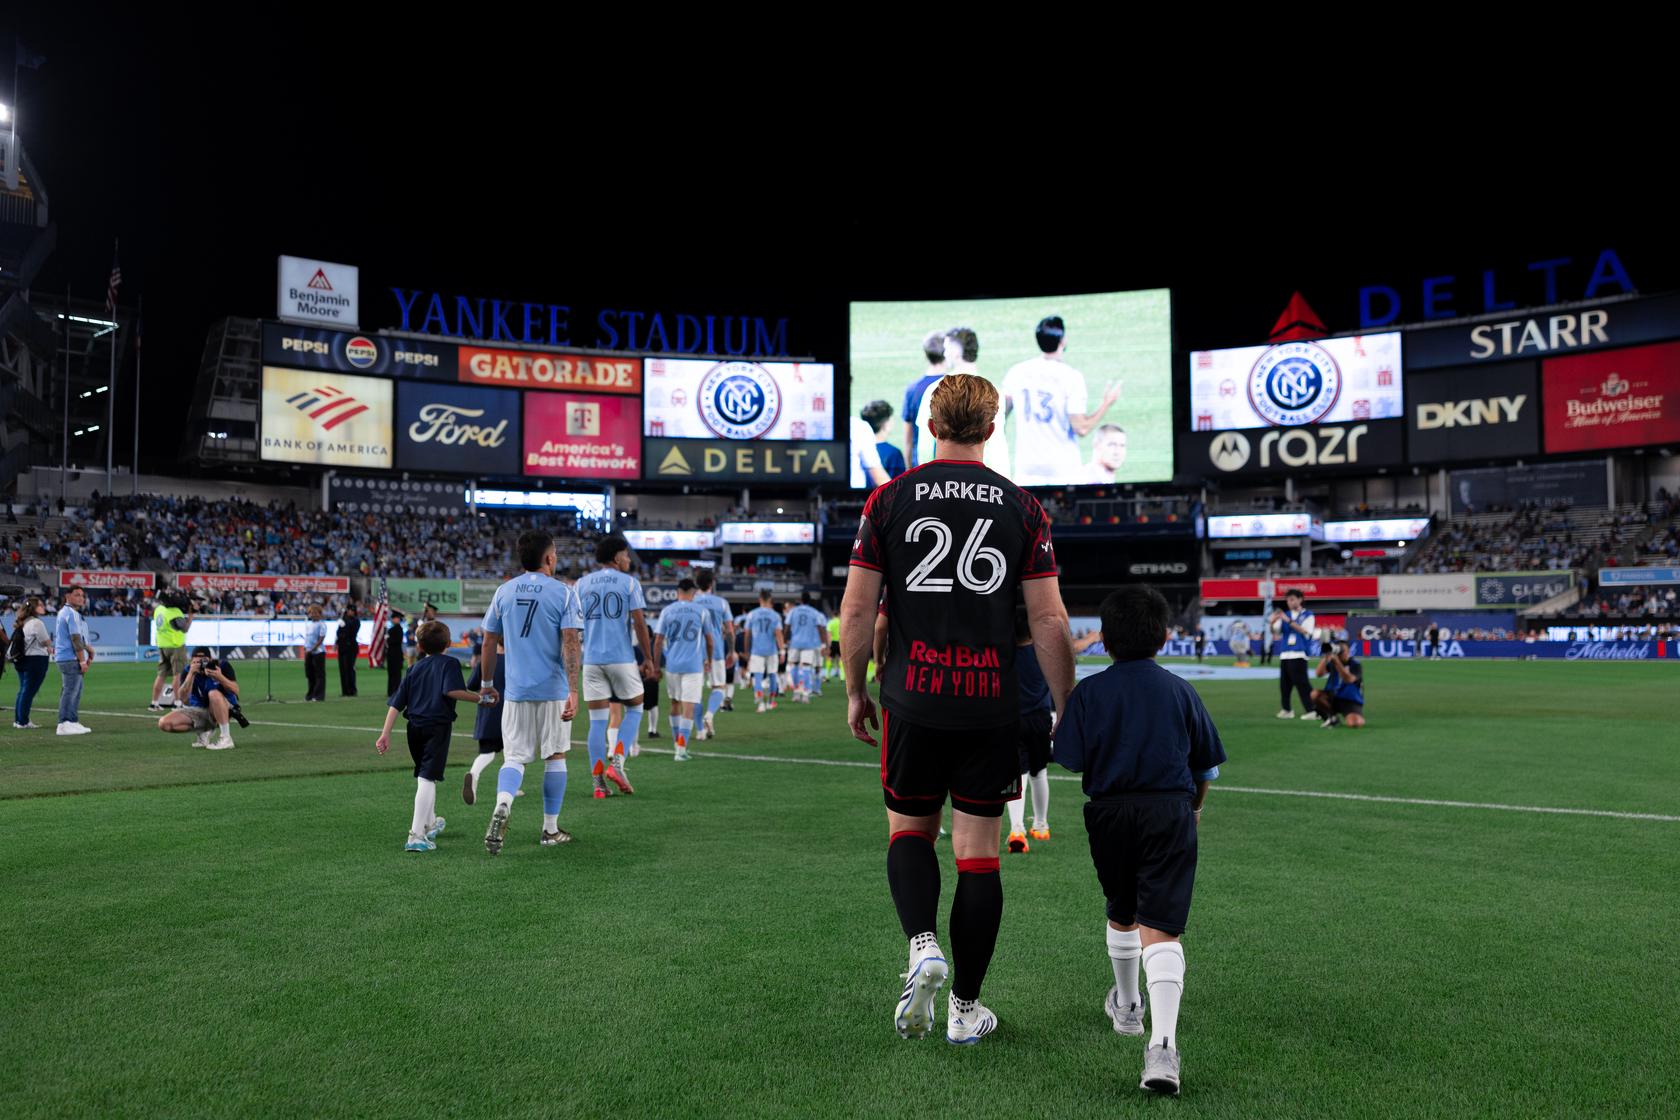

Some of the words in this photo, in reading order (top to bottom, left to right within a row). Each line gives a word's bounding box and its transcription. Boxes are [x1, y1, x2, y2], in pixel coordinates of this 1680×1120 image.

[288, 287, 350, 308] Benjamin
[1359, 249, 1636, 329] DELTA
[297, 302, 341, 318] Moore
[389, 287, 571, 347] YANKEE
[595, 309, 790, 357] STADIUM
[1469, 309, 1609, 359] STARR
[281, 337, 329, 355] PEPSI
[347, 348, 376, 358] PEPSI
[394, 350, 439, 366] PEPSI
[469, 353, 633, 387] GATORADE
[1022, 388, 1054, 424] 13
[1416, 394, 1527, 431] DKNY
[1566, 394, 1663, 417] Budweiser
[409, 404, 508, 448] Ford
[264, 437, 303, 450] BANK
[306, 441, 324, 452] OF
[327, 442, 388, 456] AMERICA
[540, 440, 624, 457] America's
[1259, 425, 1368, 468] razr
[527, 453, 565, 468] Best
[566, 454, 638, 470] Network
[703, 448, 835, 474] DELTA
[915, 481, 1004, 505] PARKER
[905, 517, 1007, 595] 26
[1129, 563, 1187, 575] ETIHAD
[418, 588, 458, 603] Eats
[515, 583, 543, 593] NICO
[585, 591, 623, 620] 20
[516, 598, 539, 638] 7
[758, 618, 771, 633] 17
[251, 631, 305, 643] ETIHA
[667, 619, 699, 643] 26
[910, 640, 951, 666] Red
[955, 646, 1000, 669] Bull
[1378, 640, 1465, 657] ULTRA
[1566, 641, 1649, 659] Michelob
[905, 664, 944, 692] NEW
[952, 669, 1001, 697] YORK
